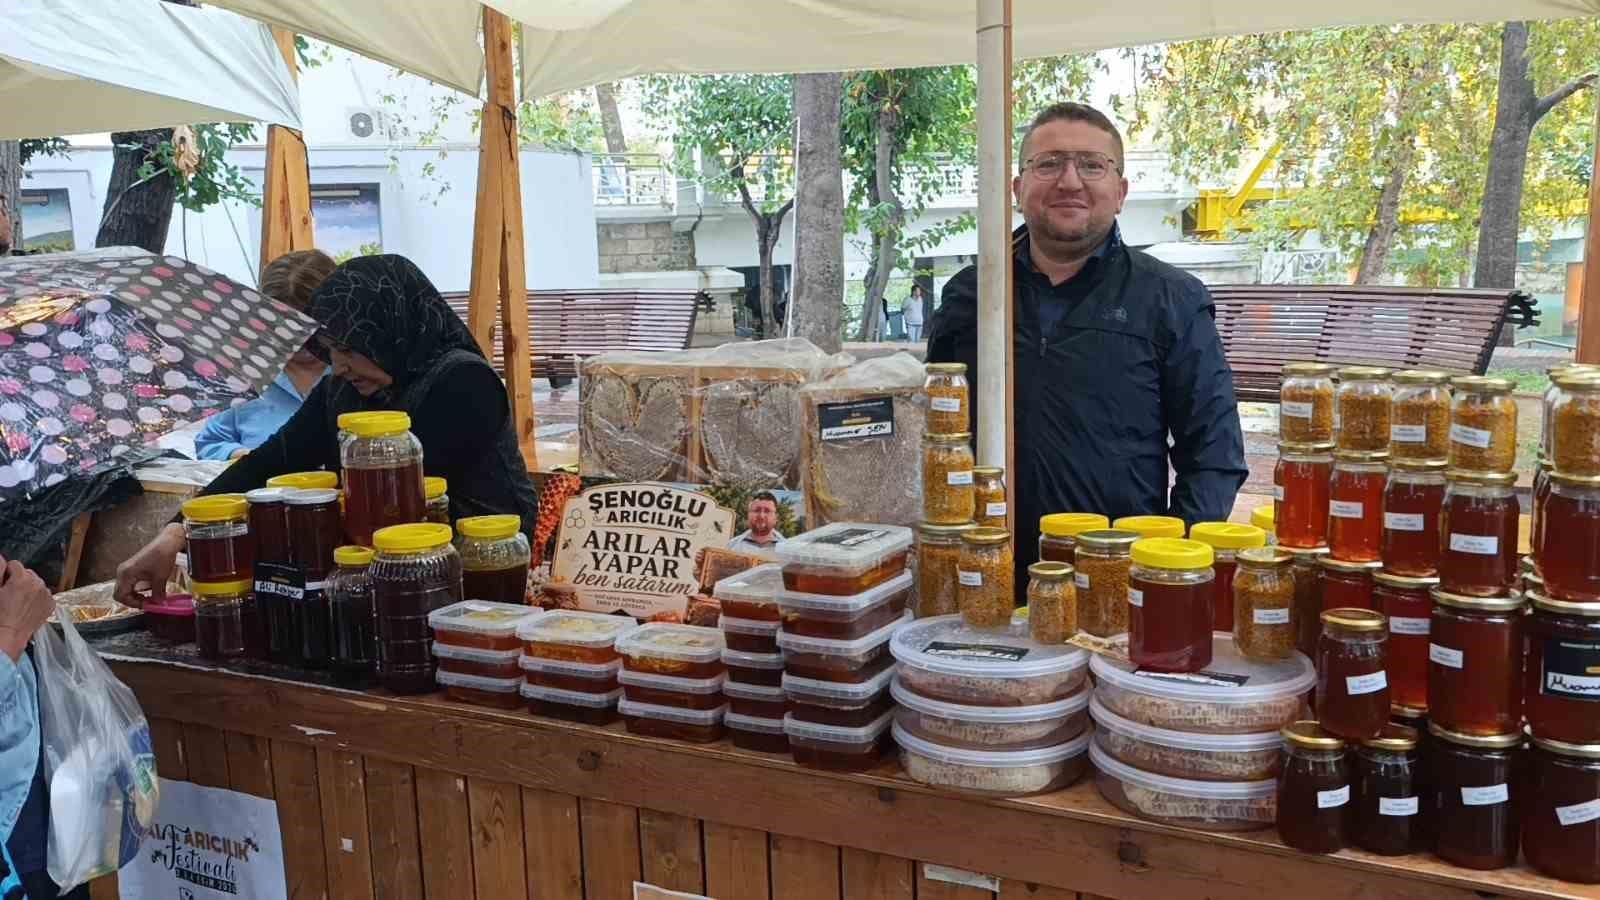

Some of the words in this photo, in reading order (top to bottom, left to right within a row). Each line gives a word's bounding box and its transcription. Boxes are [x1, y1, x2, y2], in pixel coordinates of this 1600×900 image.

[588, 490, 706, 517] ŞENOĞLU
[607, 511, 687, 530] ARICILIK
[582, 529, 692, 559] ARILAR
[573, 564, 610, 588] ben
[612, 573, 692, 595] satarım
[591, 551, 680, 579] YAPAR
[160, 823, 237, 880] Festivali
[184, 831, 249, 863] ARICILIK
